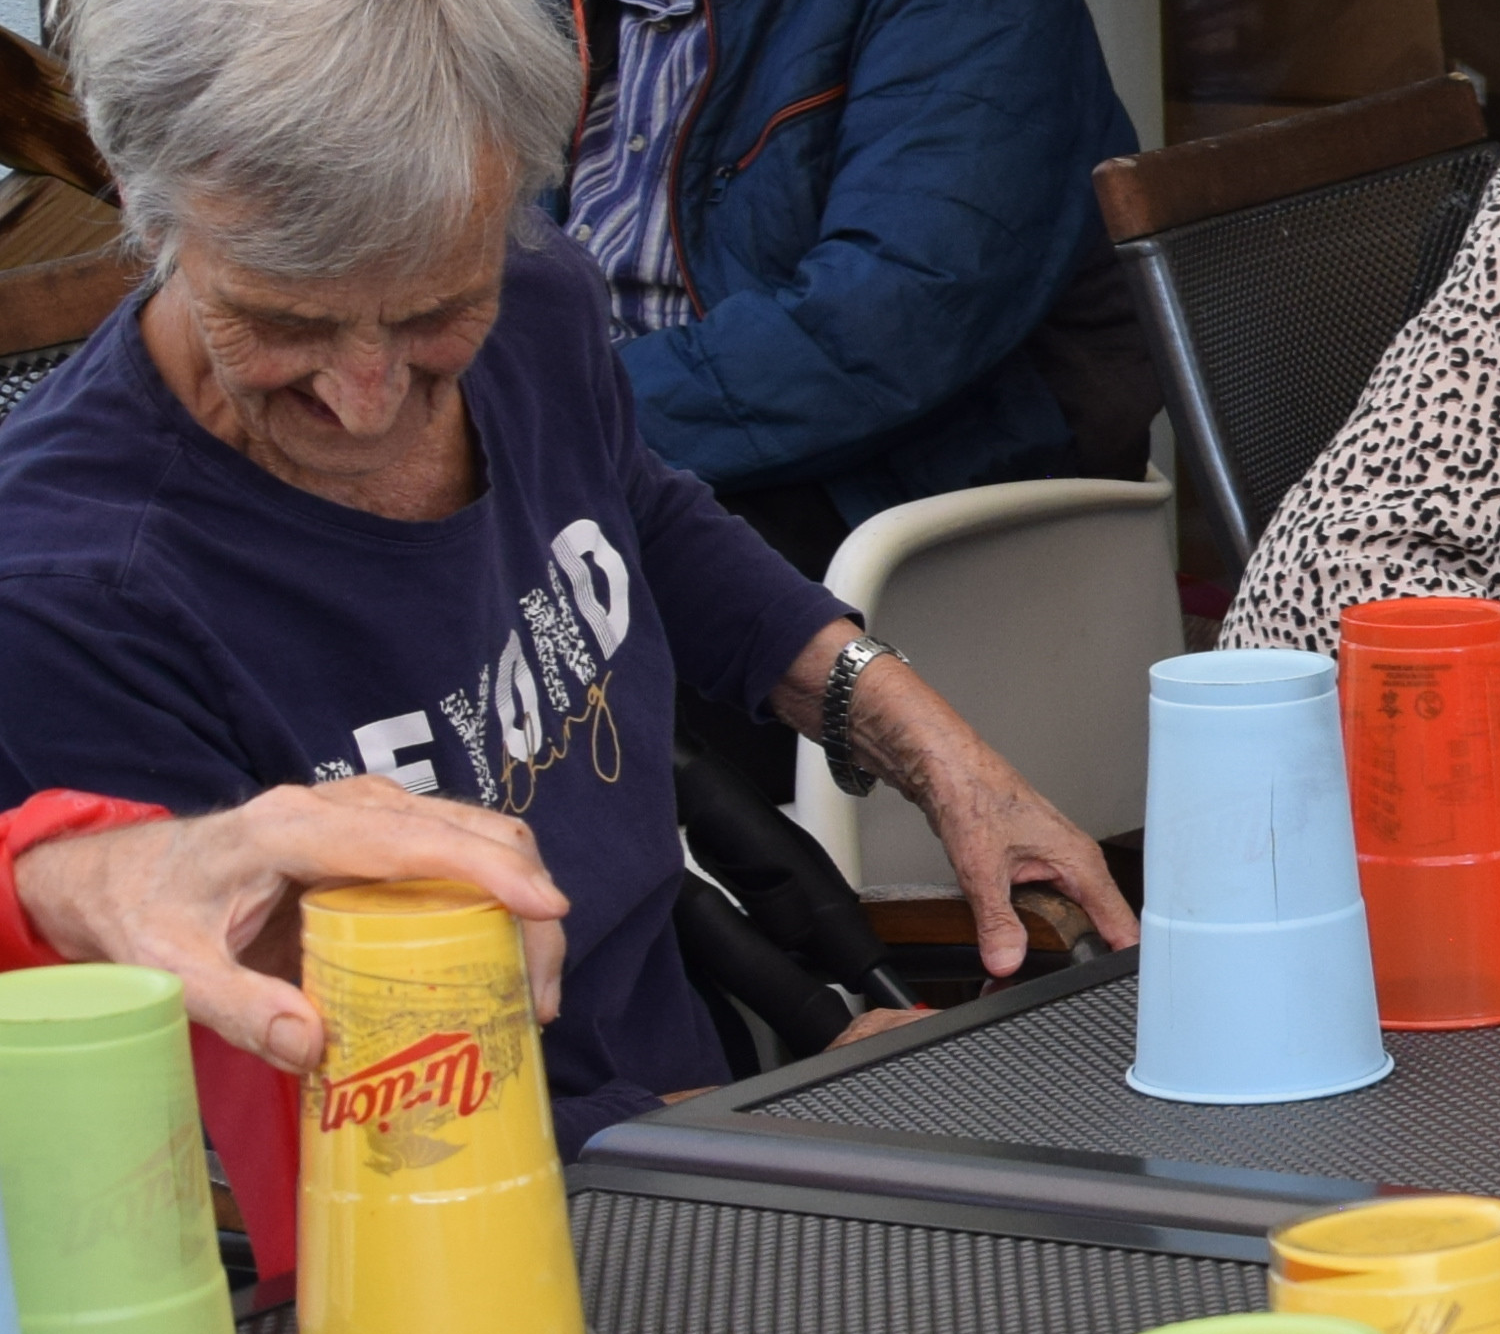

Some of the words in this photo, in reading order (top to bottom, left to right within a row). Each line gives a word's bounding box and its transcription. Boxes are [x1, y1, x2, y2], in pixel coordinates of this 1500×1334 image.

[314, 519, 630, 812] EYOND
[501, 670, 621, 814] thing
[320, 1031, 492, 1134] Union
